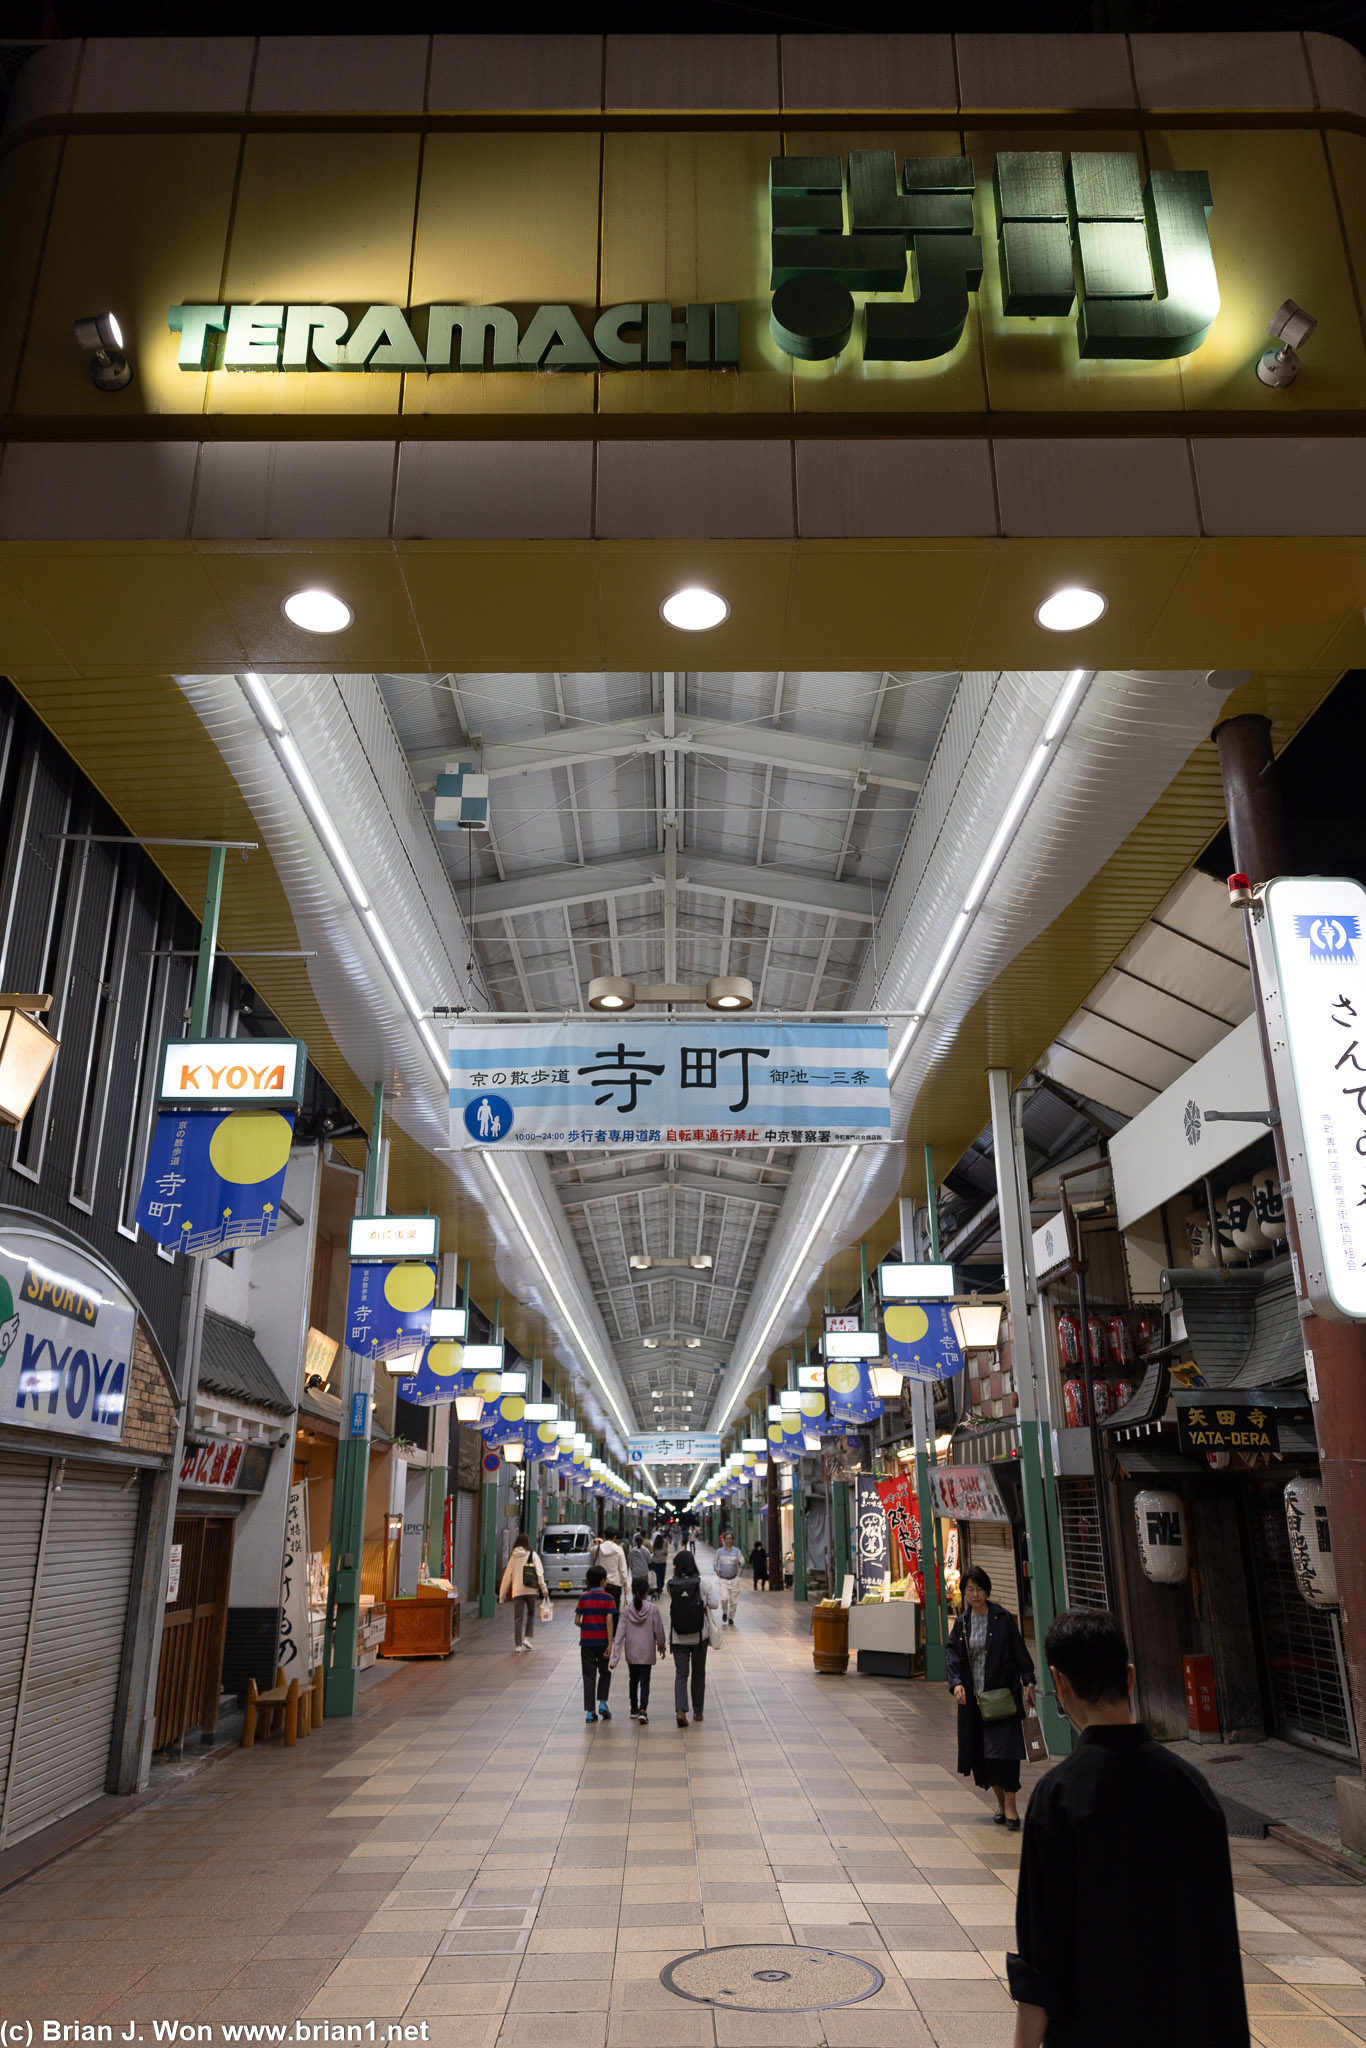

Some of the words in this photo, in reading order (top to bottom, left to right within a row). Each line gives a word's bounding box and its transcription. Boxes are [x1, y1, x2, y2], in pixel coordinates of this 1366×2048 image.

[168, 304, 739, 372] TERAMACHI
[179, 1065, 285, 1090] KYOYA
[469, 1069, 570, 1087] 京の散歩道
[577, 1043, 770, 1113] 寺町
[169, 1120, 189, 1166] 京の散歩道
[567, 1129, 661, 1143] 歩行者専用道路
[666, 1128, 760, 1142] 自転車通行禁止
[764, 1130, 831, 1143] 中京警察署
[148, 1172, 187, 1227] 寺町
[27, 1270, 96, 1321] SPORTS
[352, 1305, 372, 1343] 寺町
[16, 1332, 126, 1427] KYOYA
[1188, 1407, 1268, 1429] 矢田寺
[1189, 1431, 1271, 1446] YATA-DERA
[655, 1439, 695, 1455] 寺町
